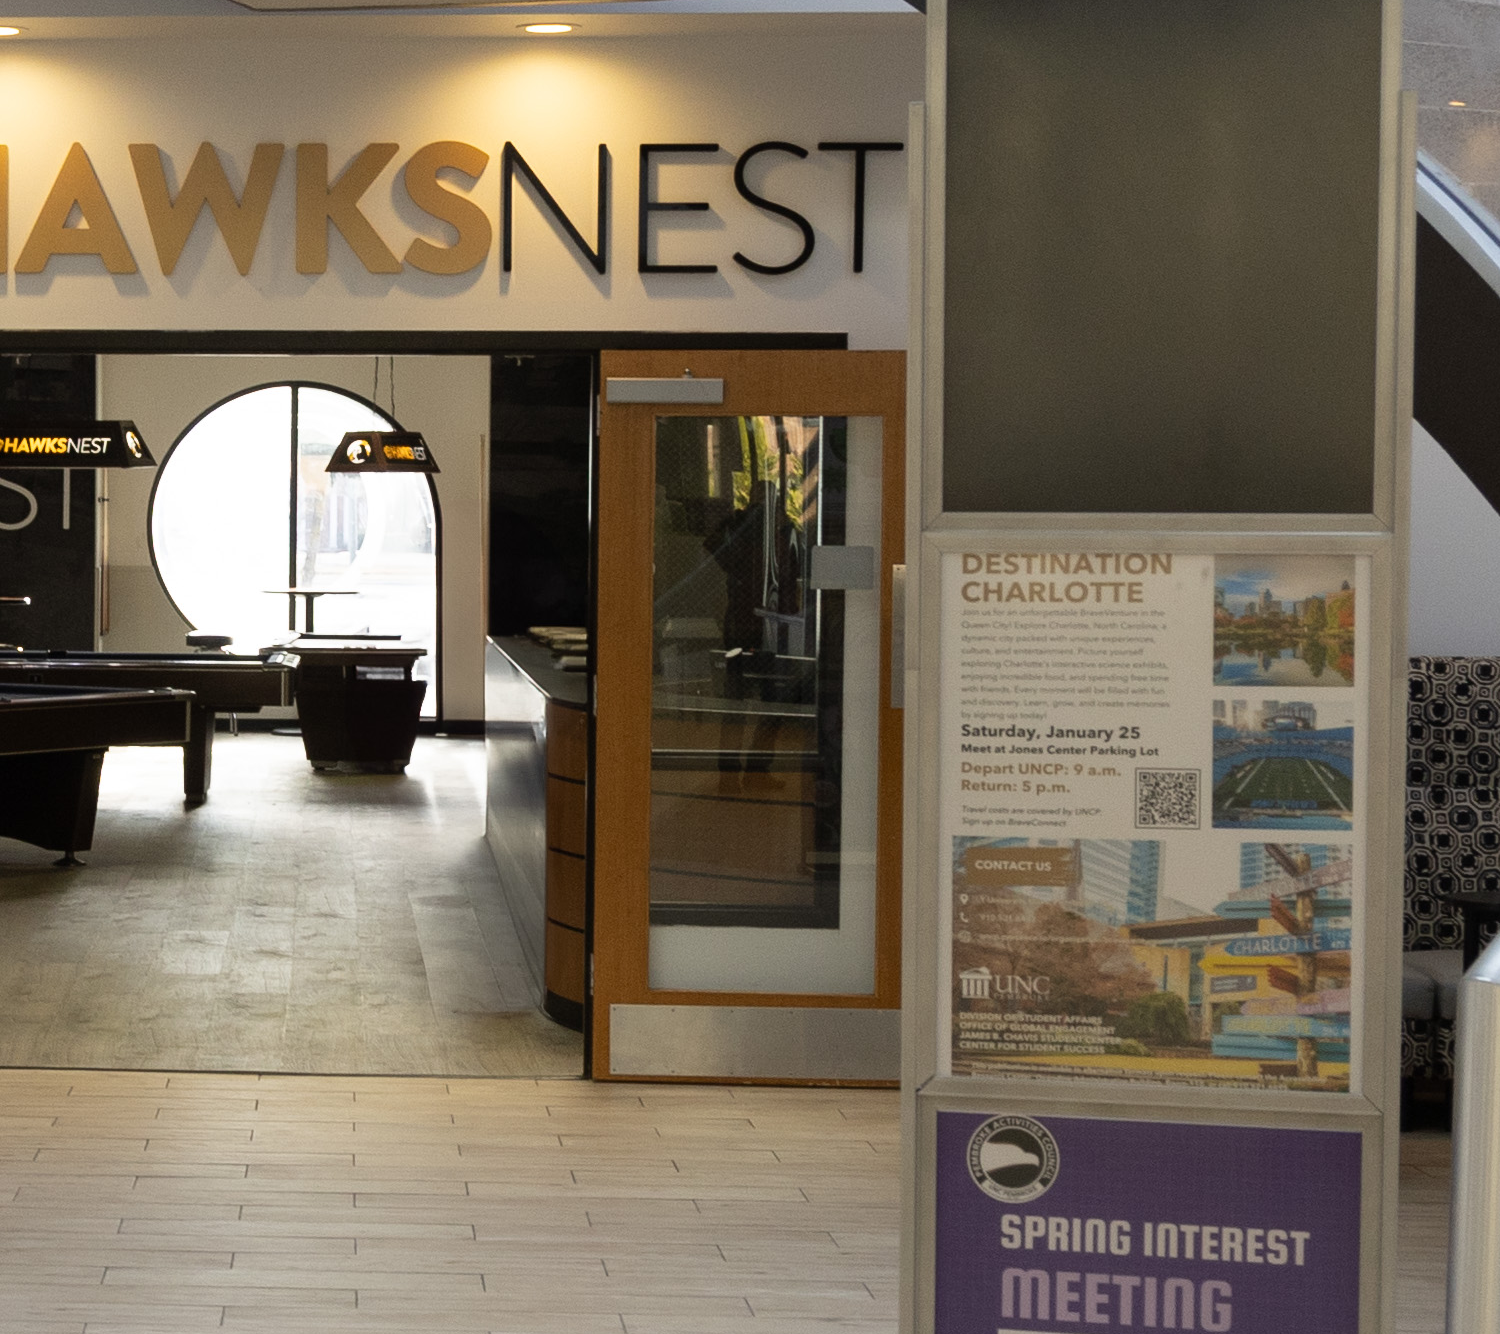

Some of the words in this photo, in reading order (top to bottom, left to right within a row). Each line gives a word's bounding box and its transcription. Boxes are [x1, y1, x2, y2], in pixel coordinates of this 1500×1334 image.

[961, 552, 1173, 575] DESTINATION
[961, 581, 1144, 603] CHARLOTTE
[961, 723, 1041, 741] Saturday,
[1046, 725, 1113, 742] January
[1118, 726, 1141, 740] 25
[961, 744, 991, 754] Meet
[994, 745, 1006, 754] at
[1008, 745, 1043, 755] Jones
[1046, 745, 1086, 756] Center
[1090, 746, 1137, 758] Parking
[1140, 747, 1159, 757] Lot
[961, 762, 1014, 778] Depart
[1018, 763, 1069, 776] UNCP:
[1073, 764, 1083, 776] 9
[1087, 766, 1122, 777] a.m.
[961, 779, 1017, 792] Return:
[1022, 781, 1031, 793] 5
[1036, 783, 1071, 796] p.m.
[974, 859, 1033, 871] CONTACT
[1035, 861, 1051, 872] US
[994, 974, 1050, 995] UNC
[959, 1011, 1001, 1020] DIVISION
[1019, 1014, 1064, 1023] STUDENT
[1064, 1015, 1103, 1025] AFFAIRS
[959, 1021, 992, 1030] OFFICE
[994, 1022, 1005, 1030] OF
[1009, 1023, 1047, 1032] GLOBAL
[1049, 1025, 1116, 1035] ENGAGEMENT
[959, 1031, 991, 1040] JAMES
[1003, 1033, 1038, 1042] CHAVIS
[1040, 1034, 1084, 1044] STUDENT
[1084, 1036, 1122, 1045] CENTER
[959, 1041, 995, 1050] CENTER
[997, 1042, 1017, 1050] FOR
[1019, 1043, 1062, 1052] STUDENT
[1063, 1045, 1105, 1054] SUCCESS
[971, 1126, 991, 1178] PEMBROKE
[993, 1117, 1043, 1137] ACTIVITIES
[1042, 1137, 1056, 1179] COUNCIL
[1001, 1213, 1131, 1256] SPRING
[1143, 1222, 1311, 1266] INTEREST
[1001, 1267, 1234, 1333] MEETING
